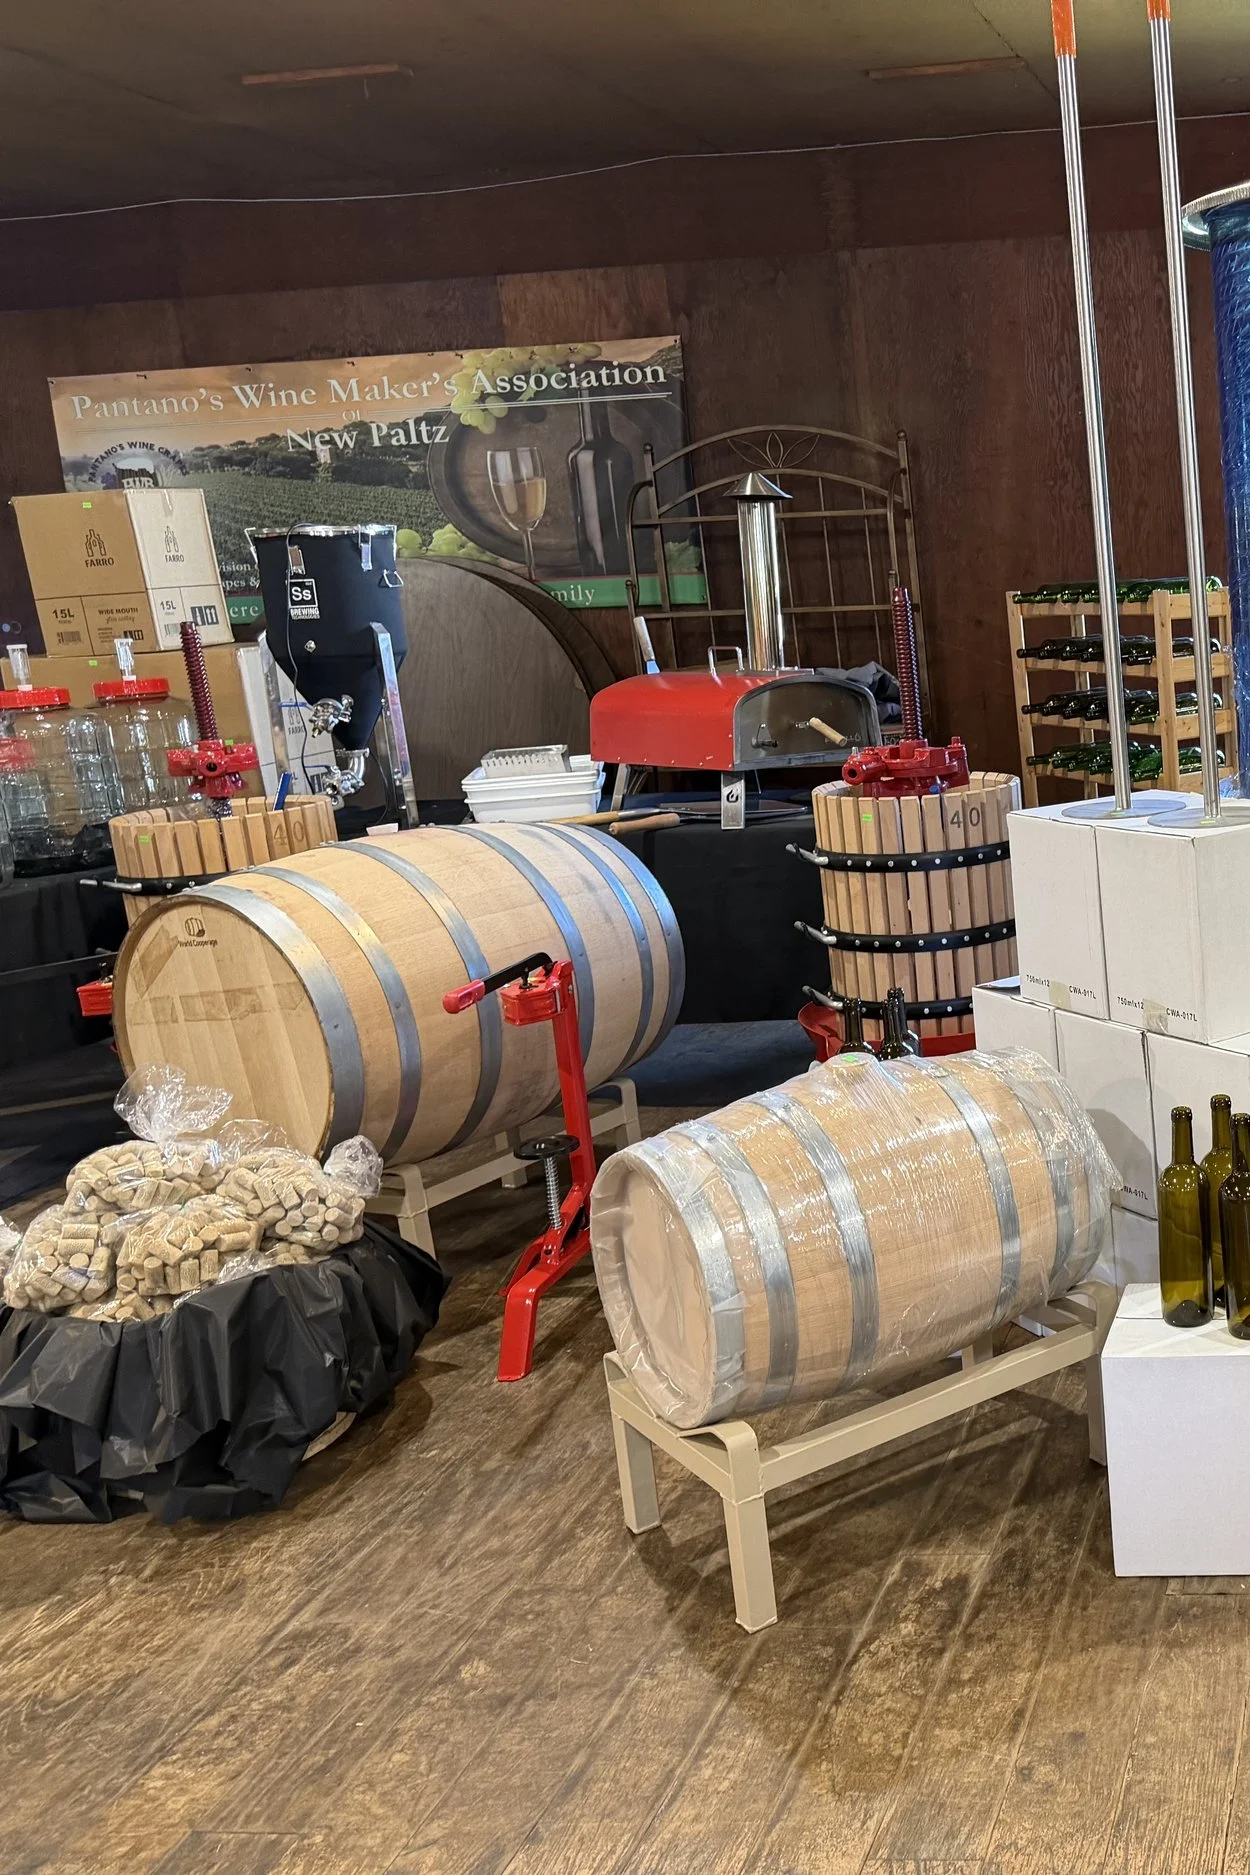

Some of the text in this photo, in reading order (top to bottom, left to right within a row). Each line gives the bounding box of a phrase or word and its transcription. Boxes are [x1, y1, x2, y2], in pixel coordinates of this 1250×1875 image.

[70, 360, 667, 421] Pantano's Wine Maker's Association
[287, 419, 450, 452] New Paltz
[88, 443, 125, 483] PANTANO'S
[127, 441, 155, 451] WINE
[85, 557, 115, 568] FARRO
[165, 554, 185, 563] FARRO
[291, 587, 312, 601] Ss
[551, 584, 595, 605] mily
[160, 600, 176, 610] 15L
[229, 604, 259, 617] ere
[290, 608, 319, 616] BREWING
[53, 607, 74, 619] 15L
[1068, 985, 1097, 999] CWA-017L
[1166, 1007, 1198, 1022] CWA-017L
[1121, 1185, 1148, 1200] WA-017L
